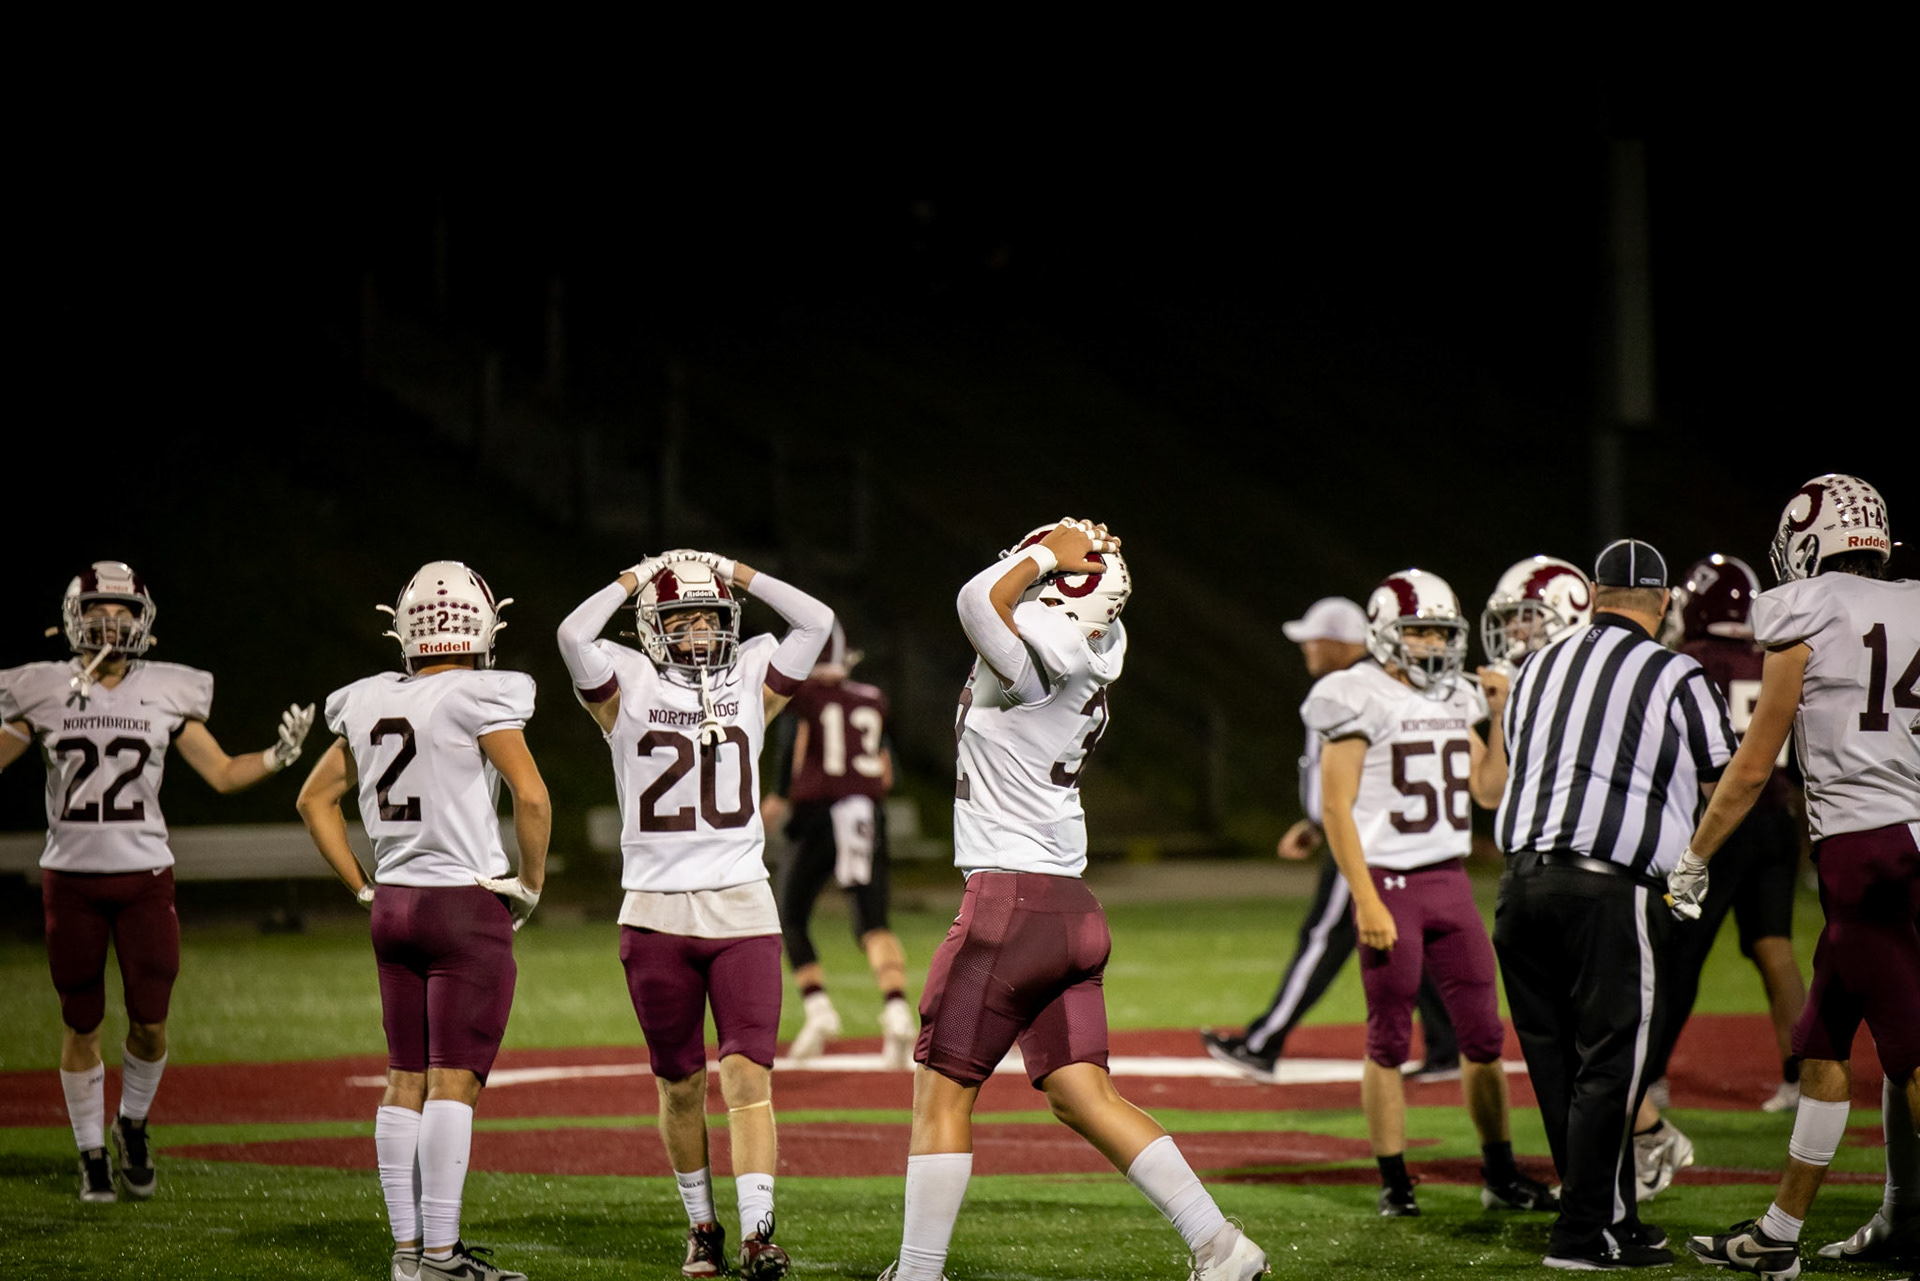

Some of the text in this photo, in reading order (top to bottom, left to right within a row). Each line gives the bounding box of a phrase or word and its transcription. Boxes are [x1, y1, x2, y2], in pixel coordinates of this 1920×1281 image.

[436, 610, 451, 632] 2
[687, 590, 714, 598] Riddell
[419, 641, 471, 654] Riddell
[63, 715, 151, 733] NORTHBRIDGE
[819, 701, 884, 777] 13
[55, 736, 151, 822] 22
[370, 717, 422, 821] 2
[637, 725, 755, 832] 20
[1389, 739, 1471, 834] 58
